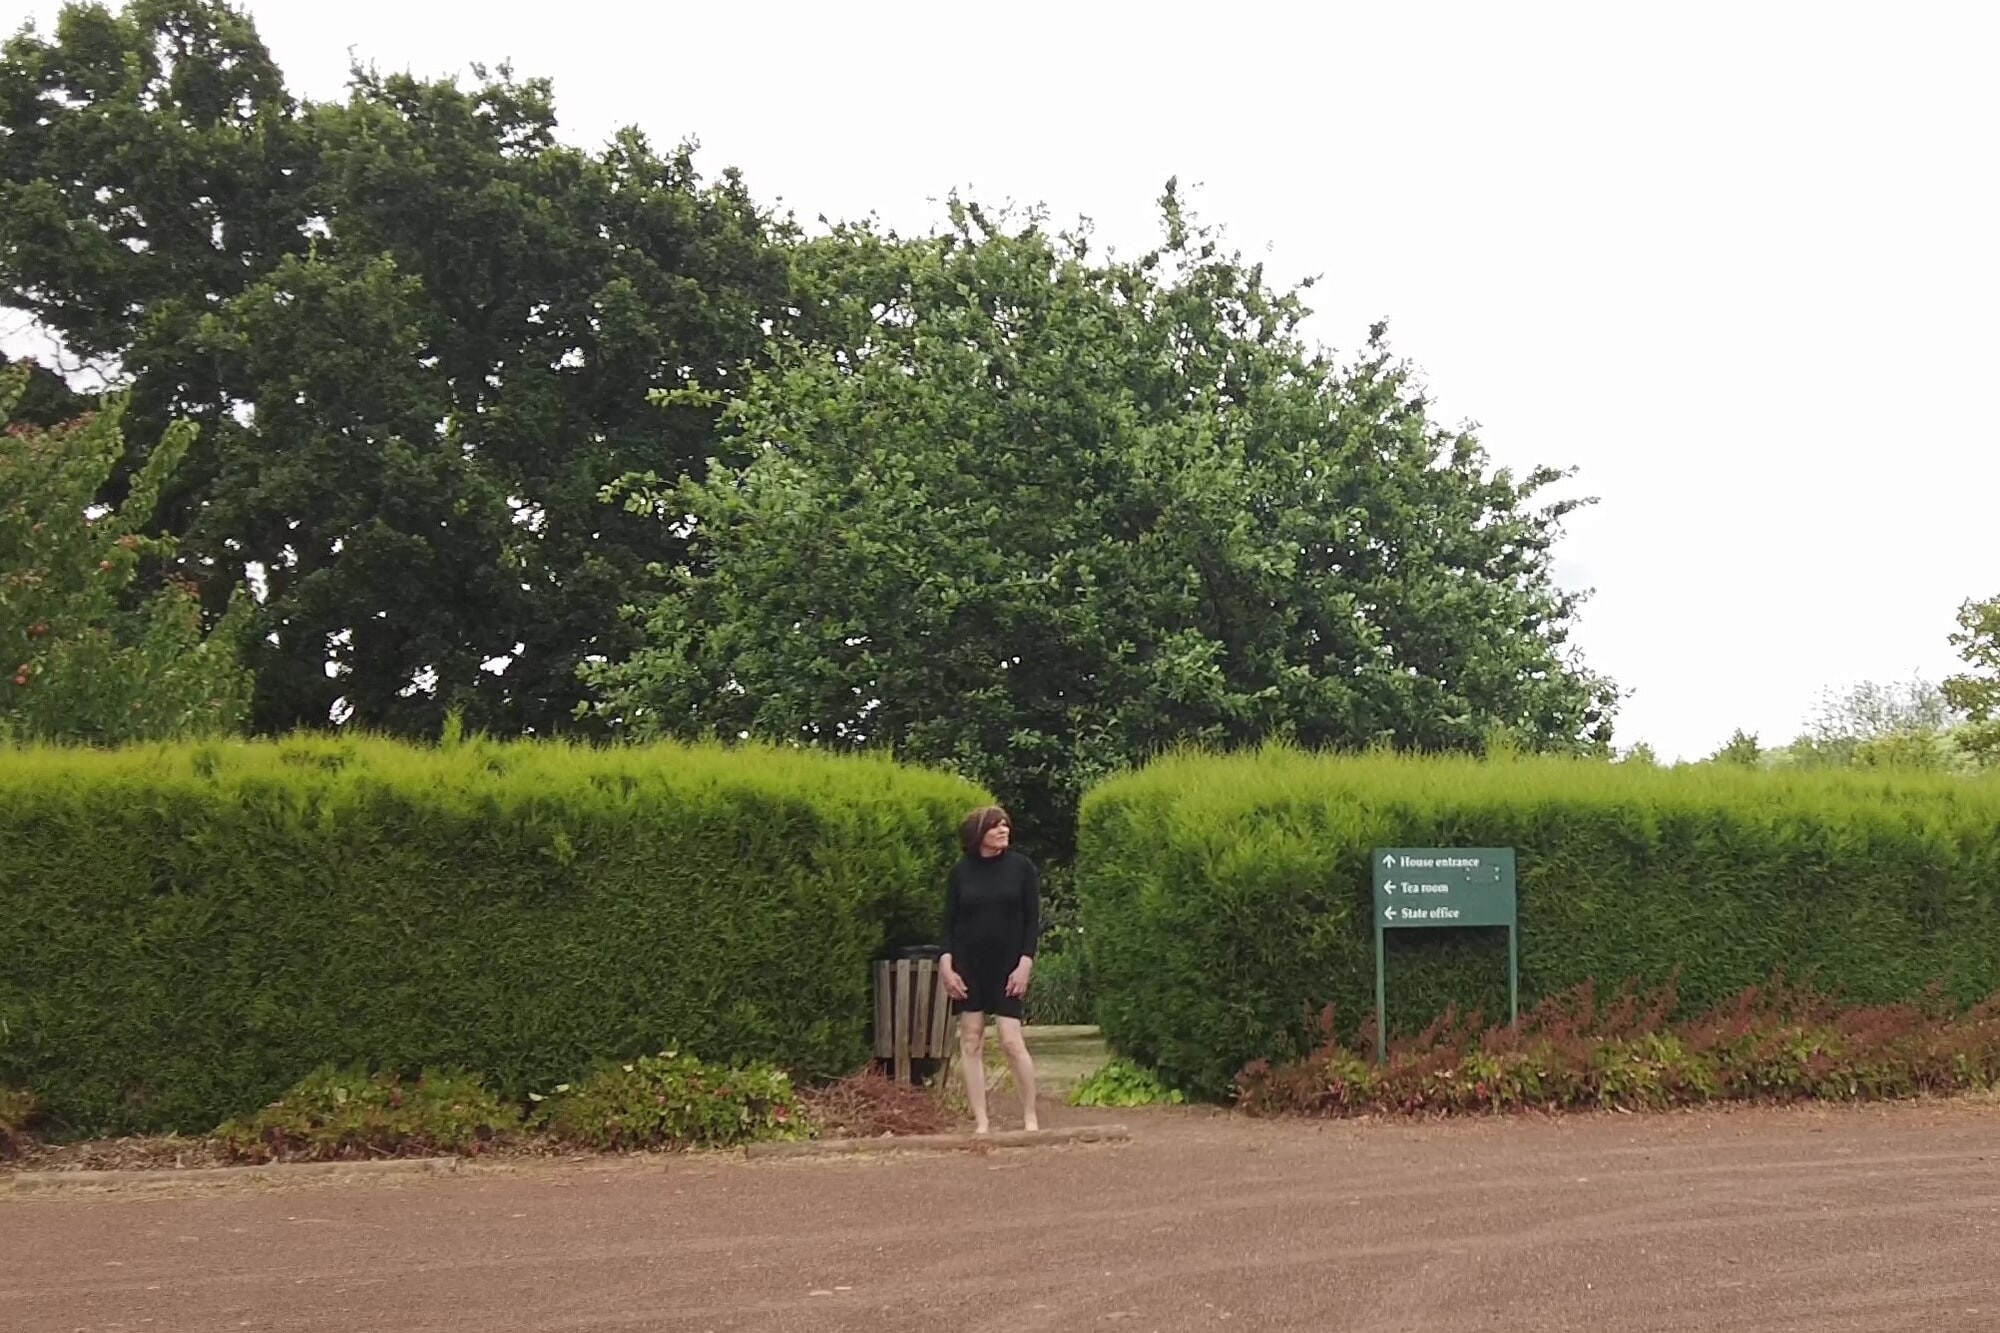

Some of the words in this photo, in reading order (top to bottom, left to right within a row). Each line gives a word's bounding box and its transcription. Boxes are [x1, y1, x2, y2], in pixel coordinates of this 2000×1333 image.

[1400, 855, 1434, 868] House
[1435, 856, 1480, 868] entrance
[1400, 881, 1420, 894] Tea
[1420, 883, 1449, 894] room
[1400, 907, 1428, 919] State
[1429, 906, 1460, 919] office
